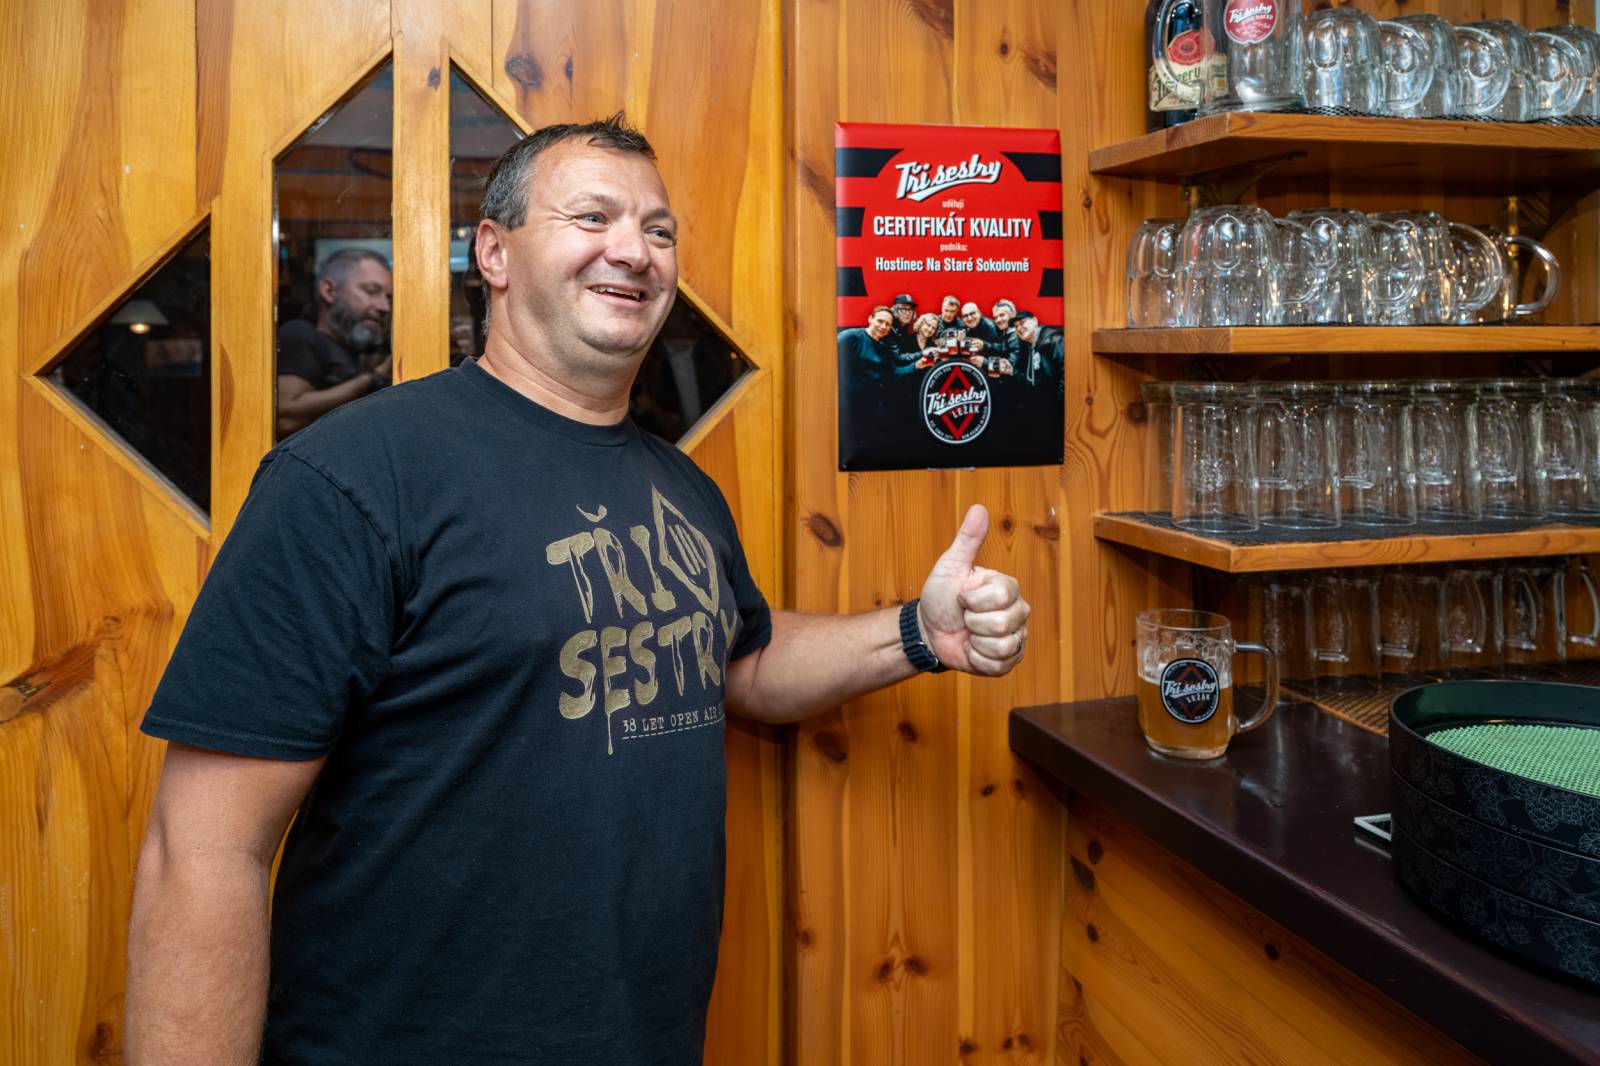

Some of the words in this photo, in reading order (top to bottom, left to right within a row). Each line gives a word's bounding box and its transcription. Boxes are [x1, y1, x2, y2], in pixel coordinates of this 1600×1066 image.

[896, 161, 931, 199] Tři
[931, 154, 1001, 186] sestry
[873, 212, 965, 237] CERTIFIKÁT
[970, 217, 1032, 238] KVALITY
[875, 257, 923, 271] Hostinec
[926, 258, 941, 271] Na
[944, 257, 973, 272] Staré
[976, 257, 1029, 273] Sokolovně
[927, 391, 947, 414] Tři
[947, 386, 987, 406] sestry
[558, 608, 737, 735] SESTRY
[622, 718, 637, 732] 38
[642, 716, 664, 732] LET
[670, 710, 699, 727] OPEN
